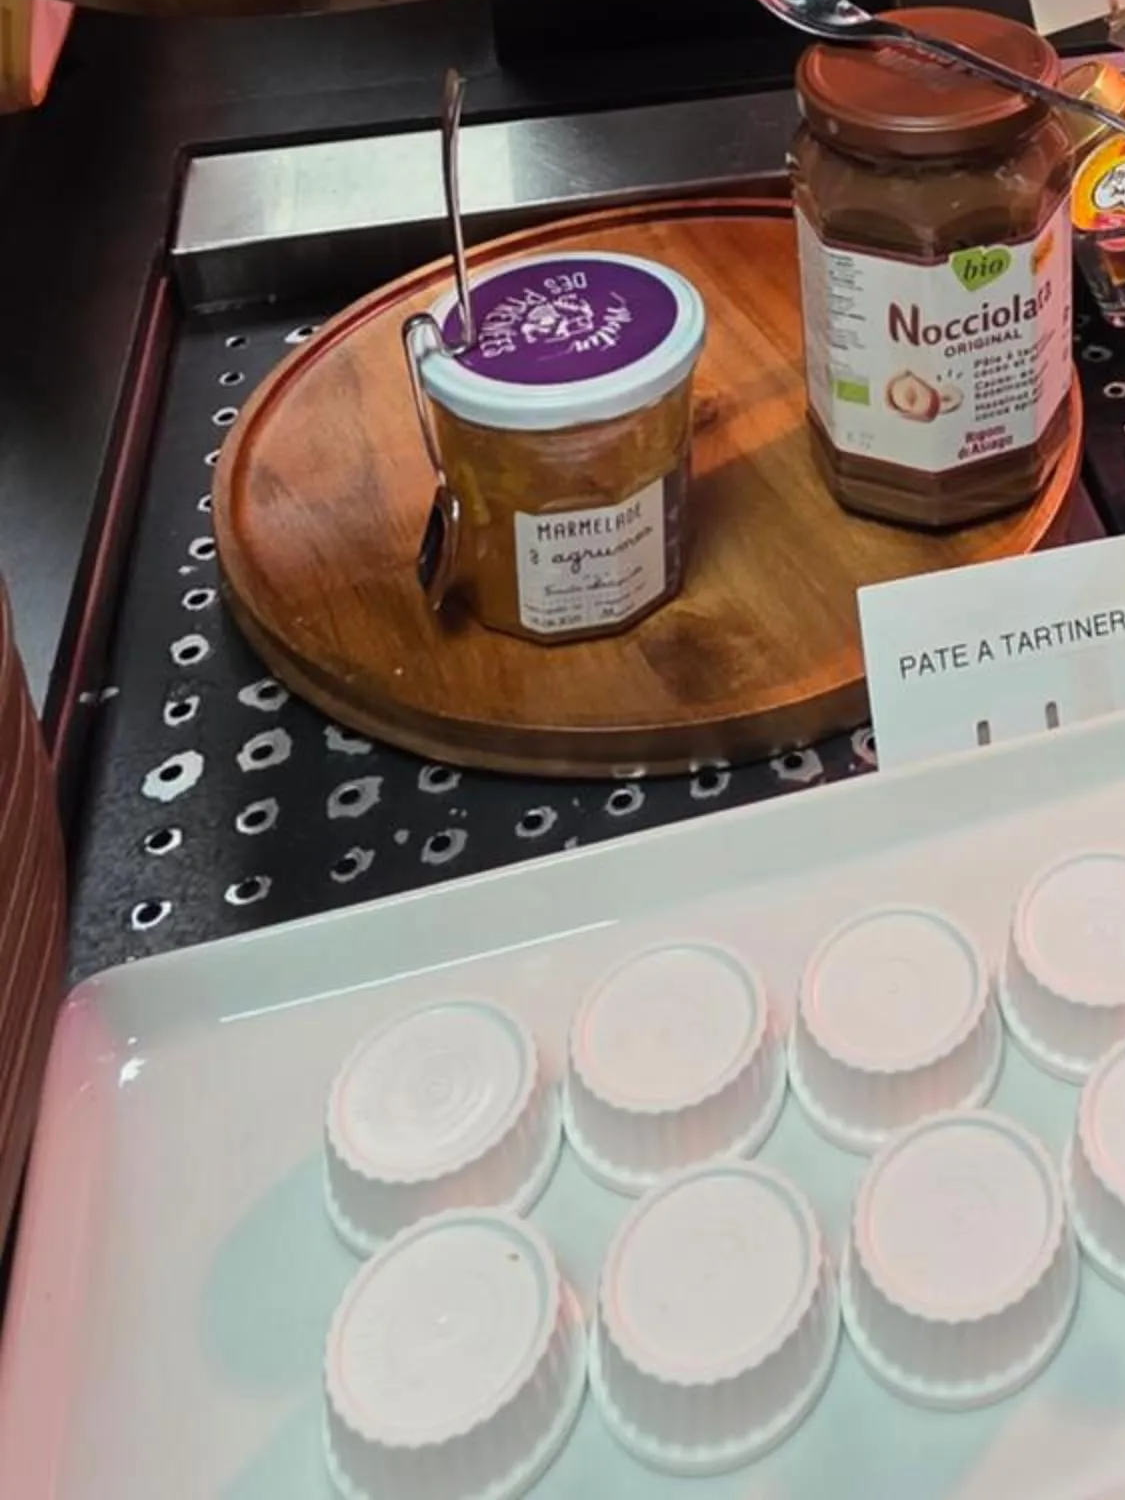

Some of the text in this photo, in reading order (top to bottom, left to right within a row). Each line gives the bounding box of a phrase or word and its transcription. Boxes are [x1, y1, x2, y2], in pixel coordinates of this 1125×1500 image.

[962, 256, 1004, 282] bio
[944, 329, 1022, 359] ORIGINAL
[537, 503, 642, 541] MARMELADE
[900, 643, 969, 680] PATE
[977, 639, 994, 662] A
